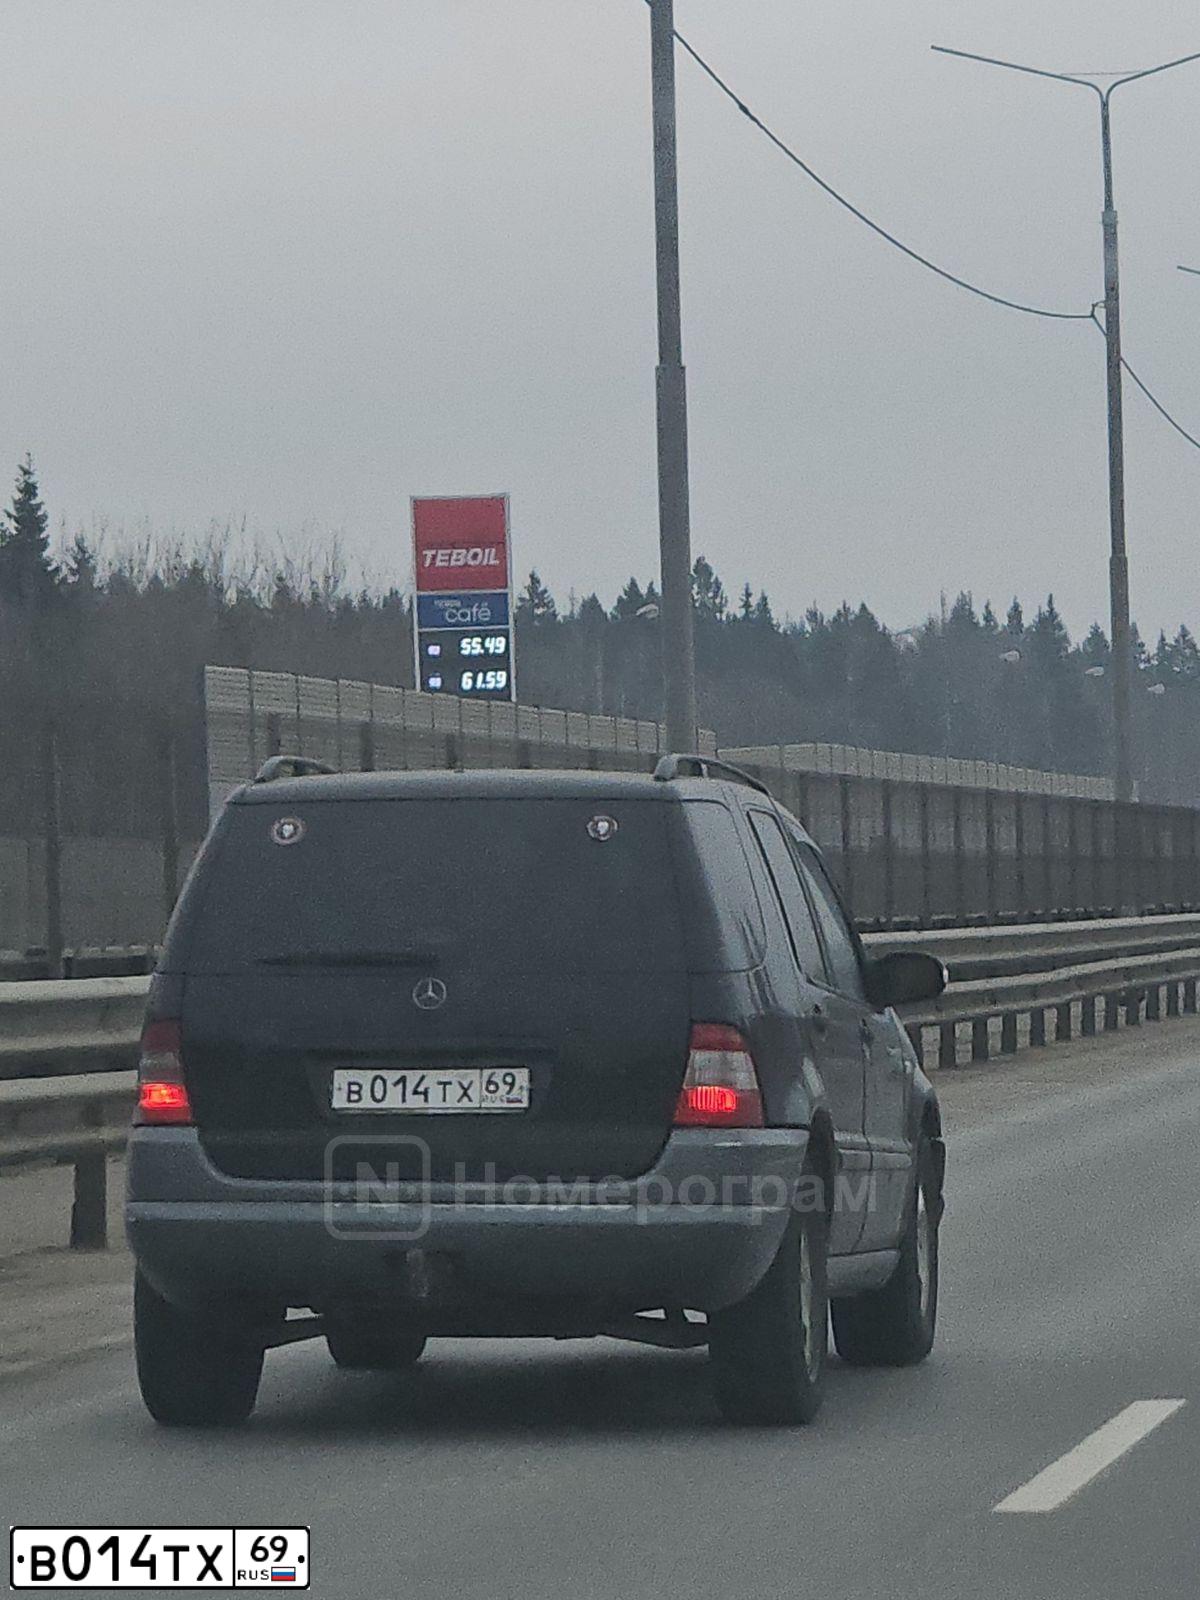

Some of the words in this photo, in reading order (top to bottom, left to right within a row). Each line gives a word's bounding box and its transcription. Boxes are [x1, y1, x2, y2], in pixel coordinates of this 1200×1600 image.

[422, 548, 499, 567] TEBOIL
[460, 636, 506, 656] 55.49
[461, 670, 508, 690] 61.59
